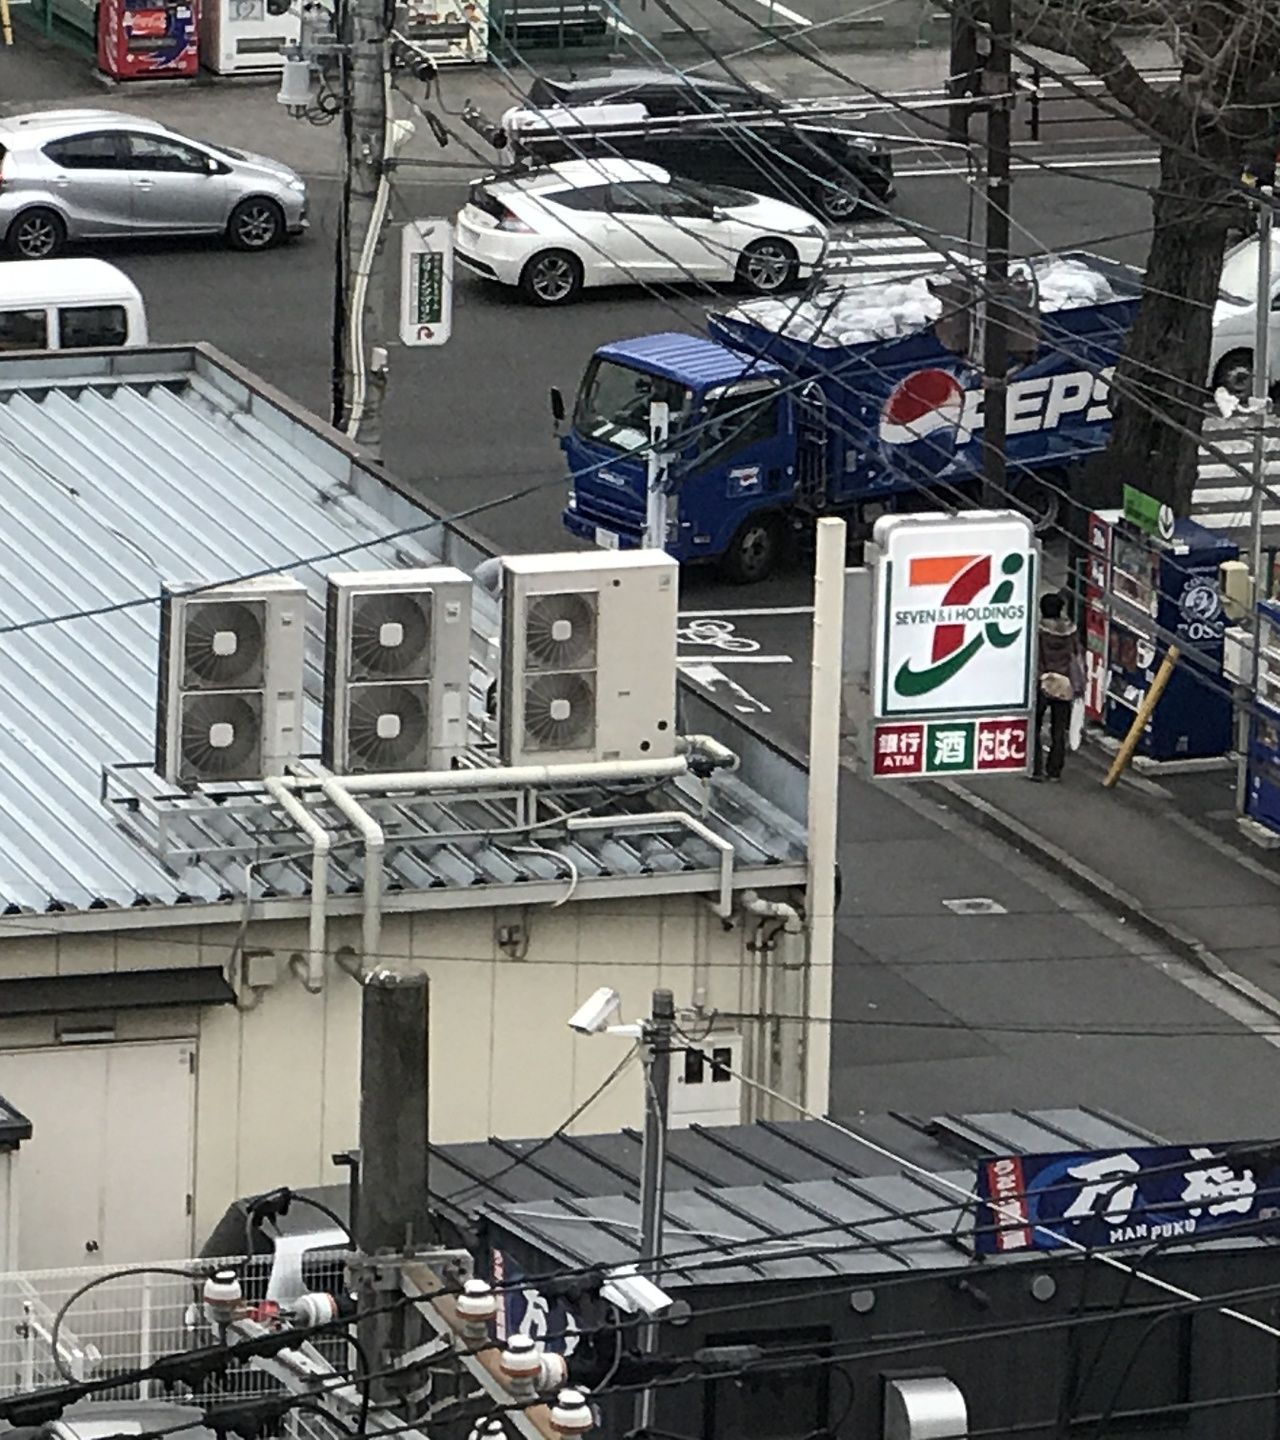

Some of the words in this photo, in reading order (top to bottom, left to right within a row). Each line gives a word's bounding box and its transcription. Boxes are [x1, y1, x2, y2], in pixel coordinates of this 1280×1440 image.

[895, 610, 938, 625] SEVEN
[955, 605, 1025, 621] HOLDINGS
[878, 732, 921, 754] 銀行
[934, 730, 967, 765] 酒
[979, 727, 1026, 762] たばこ
[883, 755, 915, 768] ATM
[1109, 1224, 1148, 1244] MAN
[1150, 1218, 1197, 1241] PUKU
